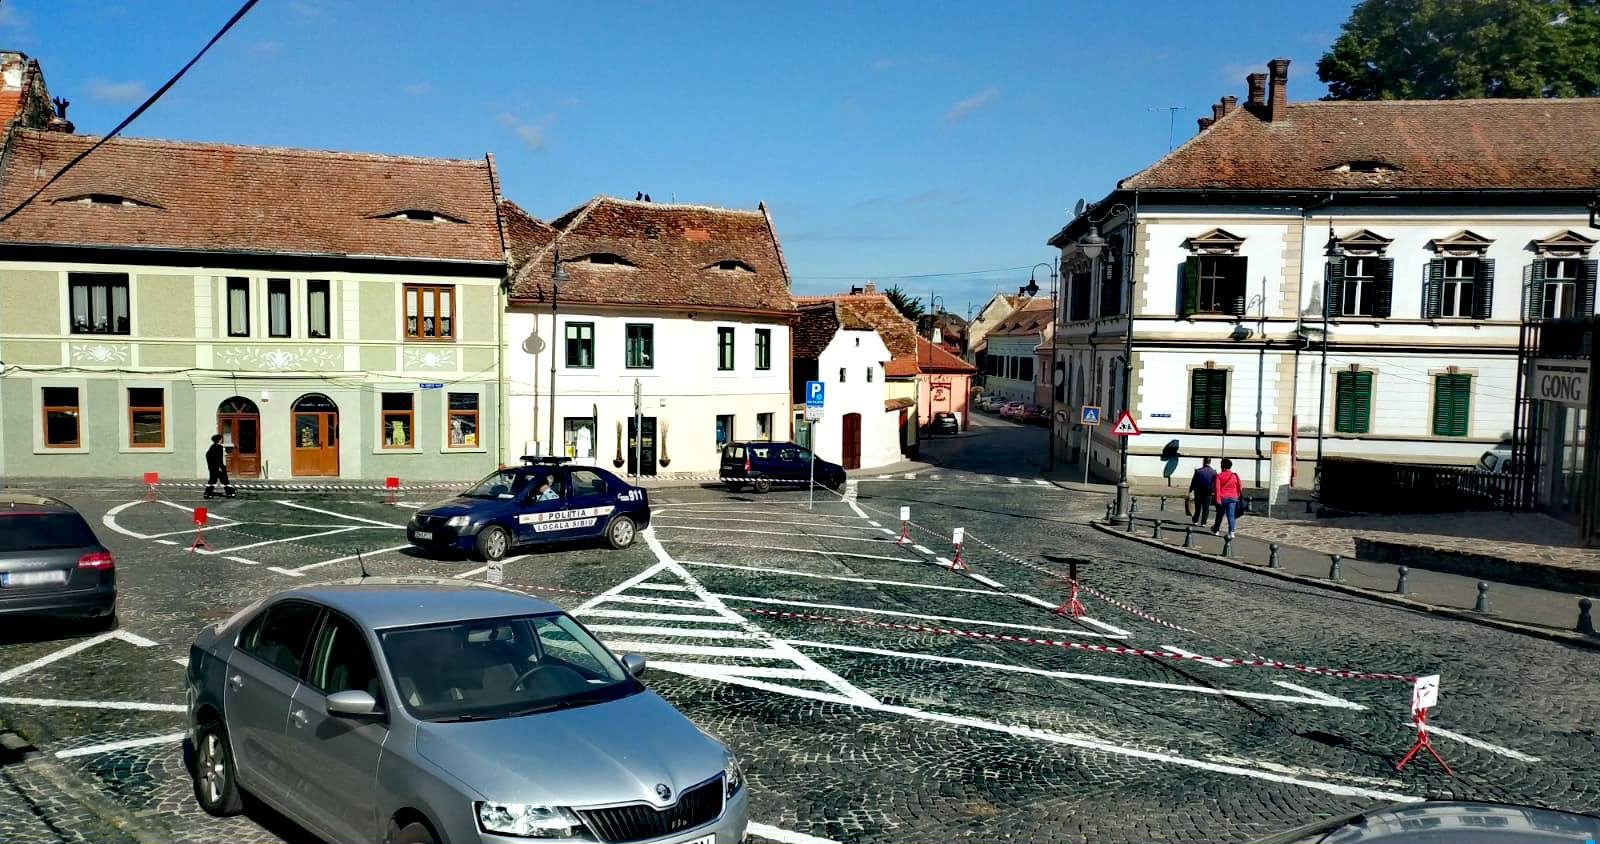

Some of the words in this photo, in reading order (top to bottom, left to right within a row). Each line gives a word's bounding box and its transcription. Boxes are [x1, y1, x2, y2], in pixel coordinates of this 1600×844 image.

[811, 383, 822, 398] P
[1541, 374, 1582, 401] GONG
[628, 489, 643, 502] 911
[572, 519, 594, 528] SIBIU
